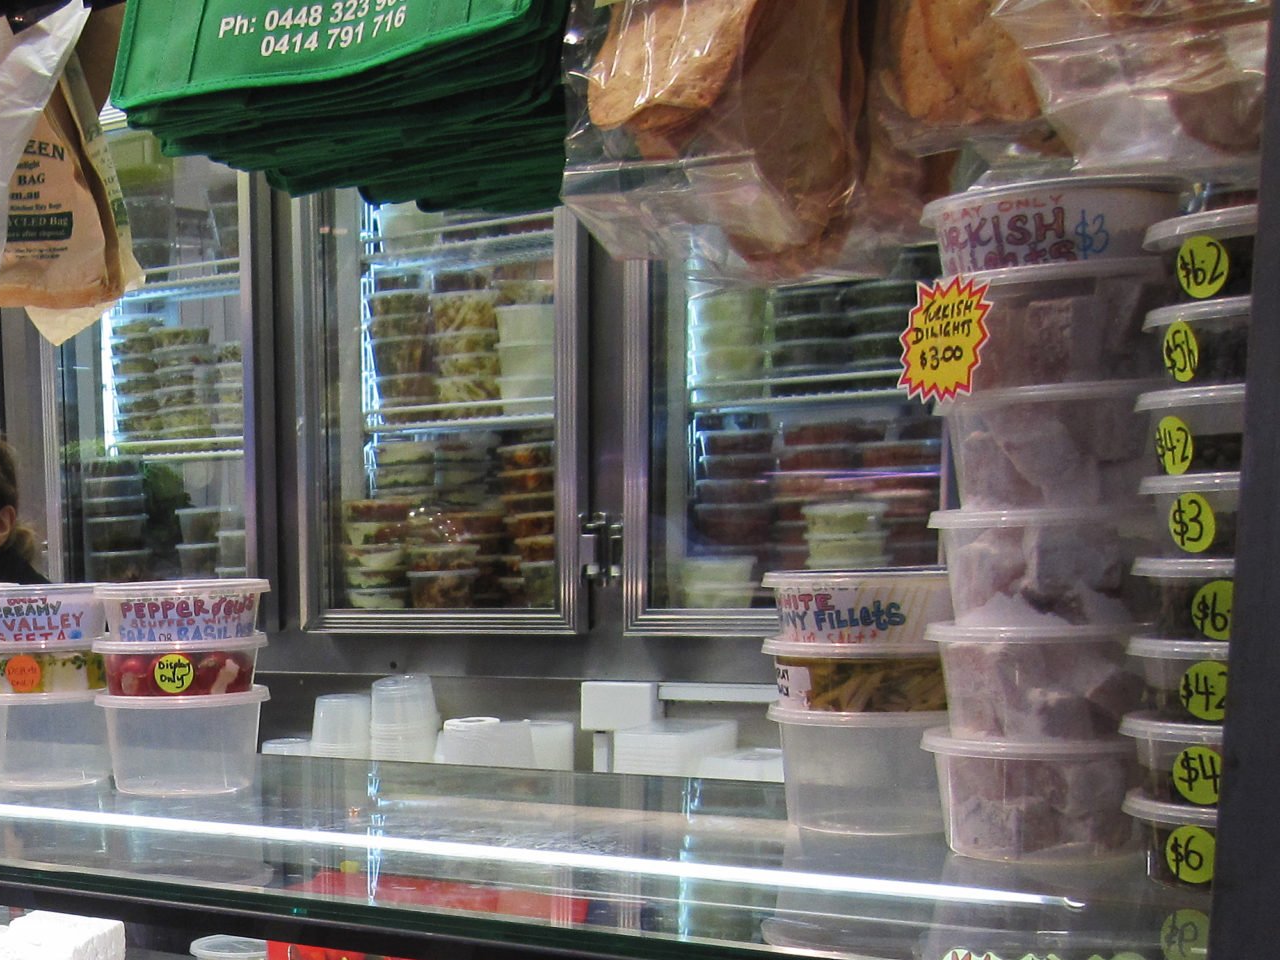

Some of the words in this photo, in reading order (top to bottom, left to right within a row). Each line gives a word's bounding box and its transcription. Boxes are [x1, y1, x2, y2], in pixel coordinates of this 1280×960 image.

[219, 16, 257, 38] Ph:
[265, 5, 323, 31] 0448
[329, 0, 369, 23] 323
[261, 31, 319, 57] 0414
[327, 22, 364, 49] 791
[372, 6, 407, 37] 716
[17, 173, 46, 186] BAG
[997, 194, 1064, 213] ONLY
[1074, 209, 1111, 258] $3
[922, 300, 974, 325] TURKISH
[911, 319, 974, 345] DILIGHTS
[920, 345, 964, 370] $3.00
[1173, 499, 1204, 547] $3
[2, 611, 84, 632] VALLEY
[176, 625, 233, 642] BASIL
[157, 659, 191, 677] Display
[1178, 751, 1220, 794] $4
[1170, 835, 1205, 871] $6
